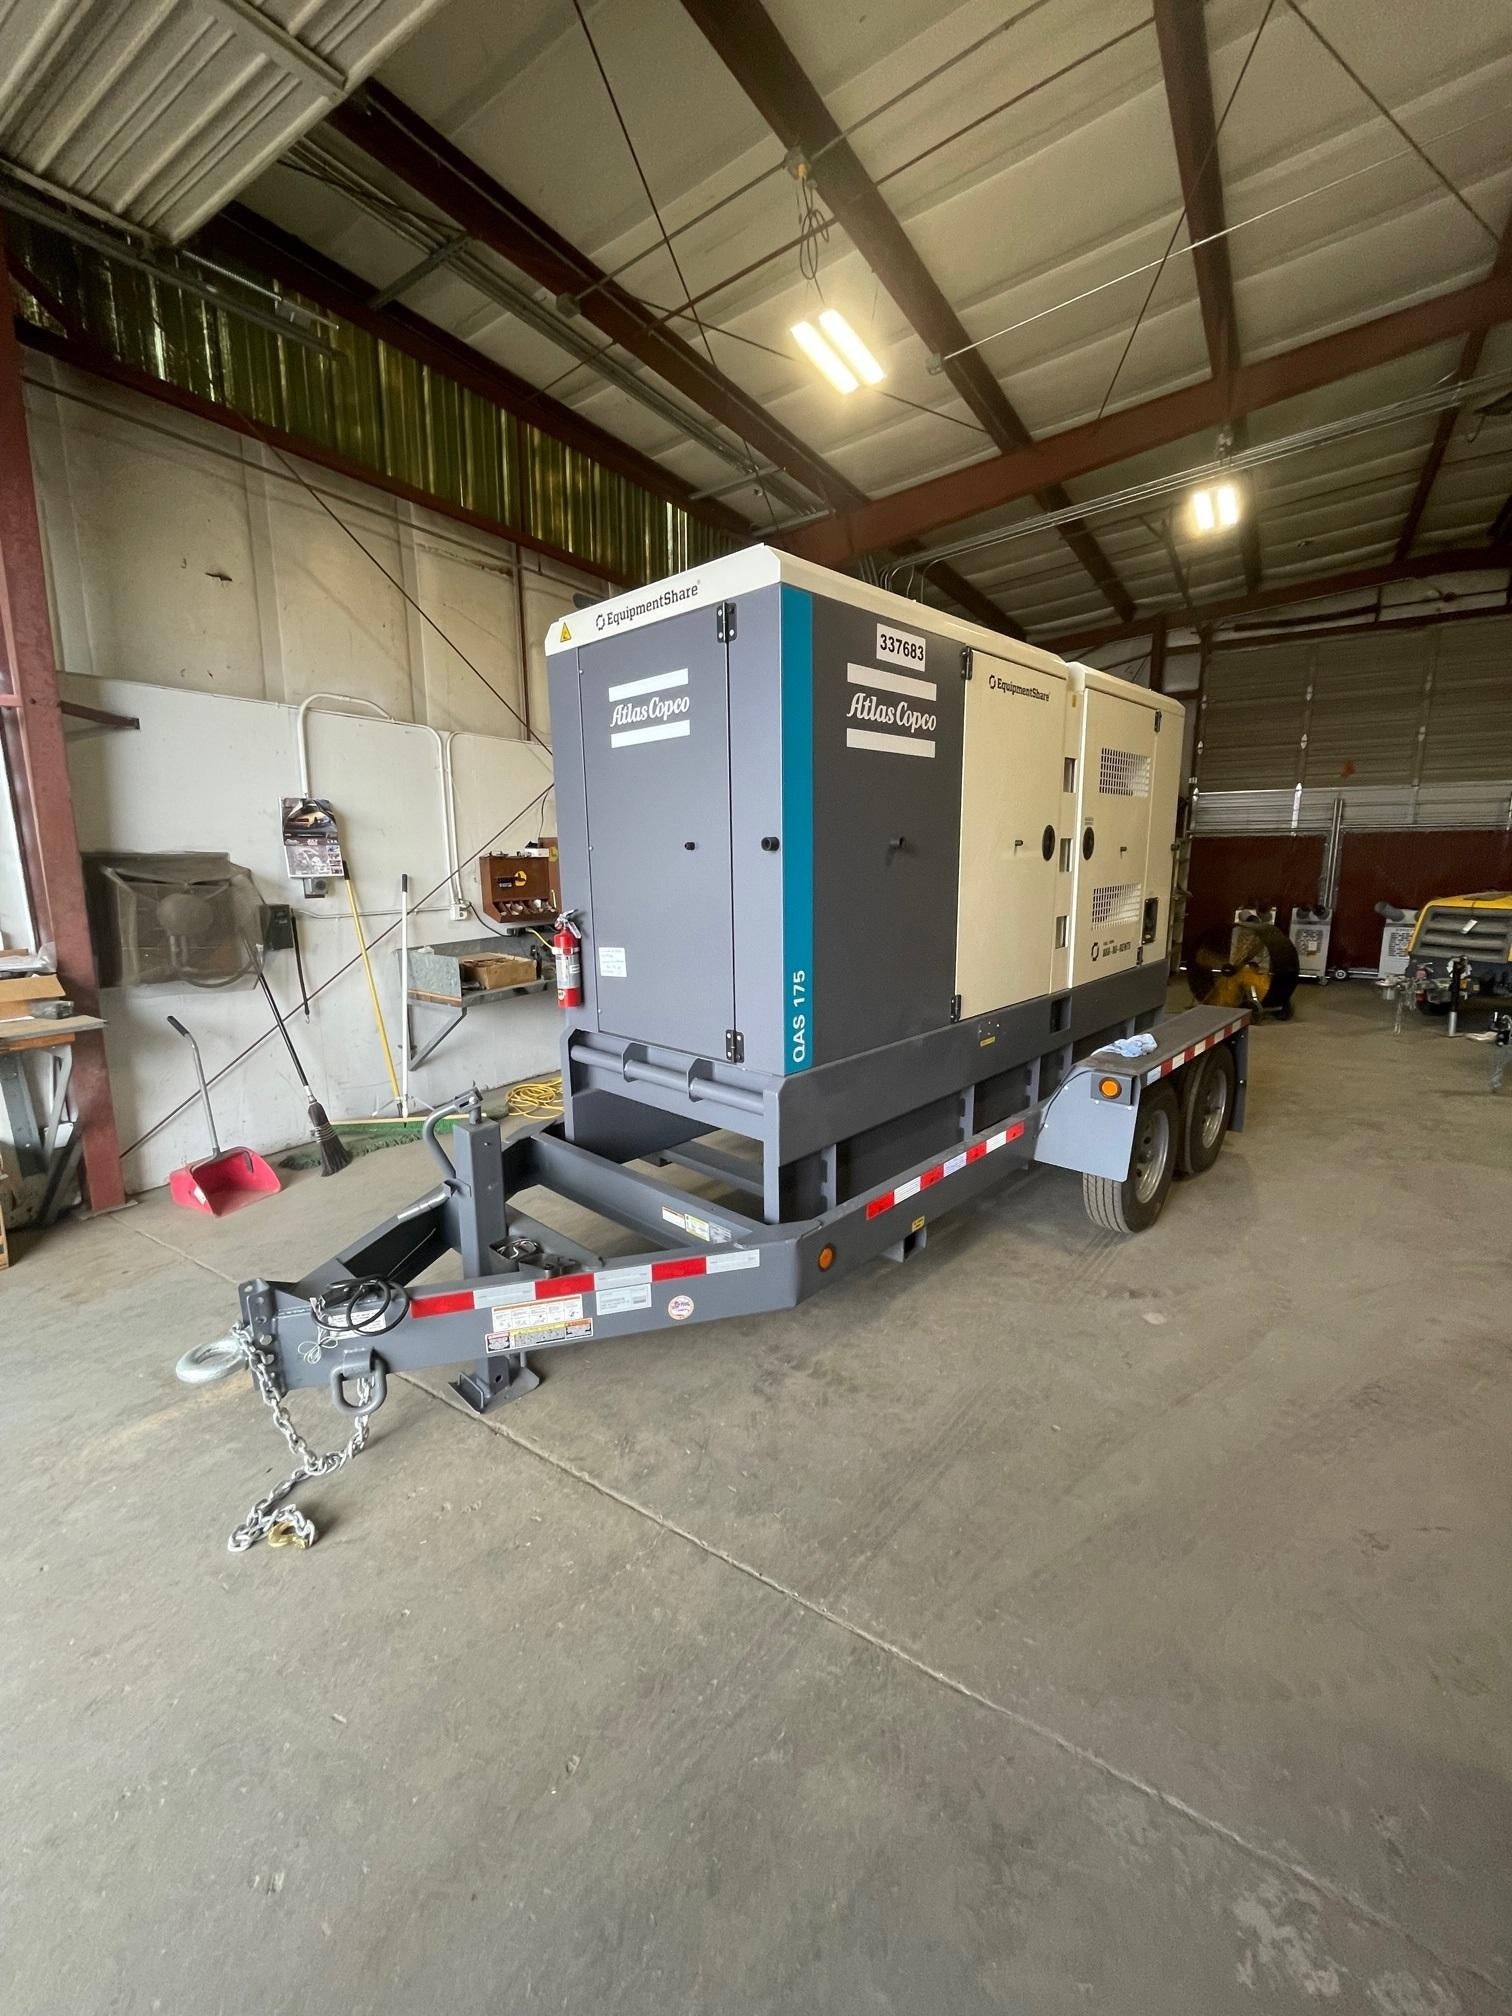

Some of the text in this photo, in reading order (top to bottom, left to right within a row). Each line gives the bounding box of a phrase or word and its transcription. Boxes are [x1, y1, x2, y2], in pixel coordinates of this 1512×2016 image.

[607, 585, 698, 625] EquipmentShare
[880, 634, 924, 661] 337683
[997, 677, 1050, 702] EquipmentShare
[610, 696, 690, 727] Atlas Copco
[845, 692, 937, 733] Atlas Copco
[793, 970, 806, 1063] QAS 175
